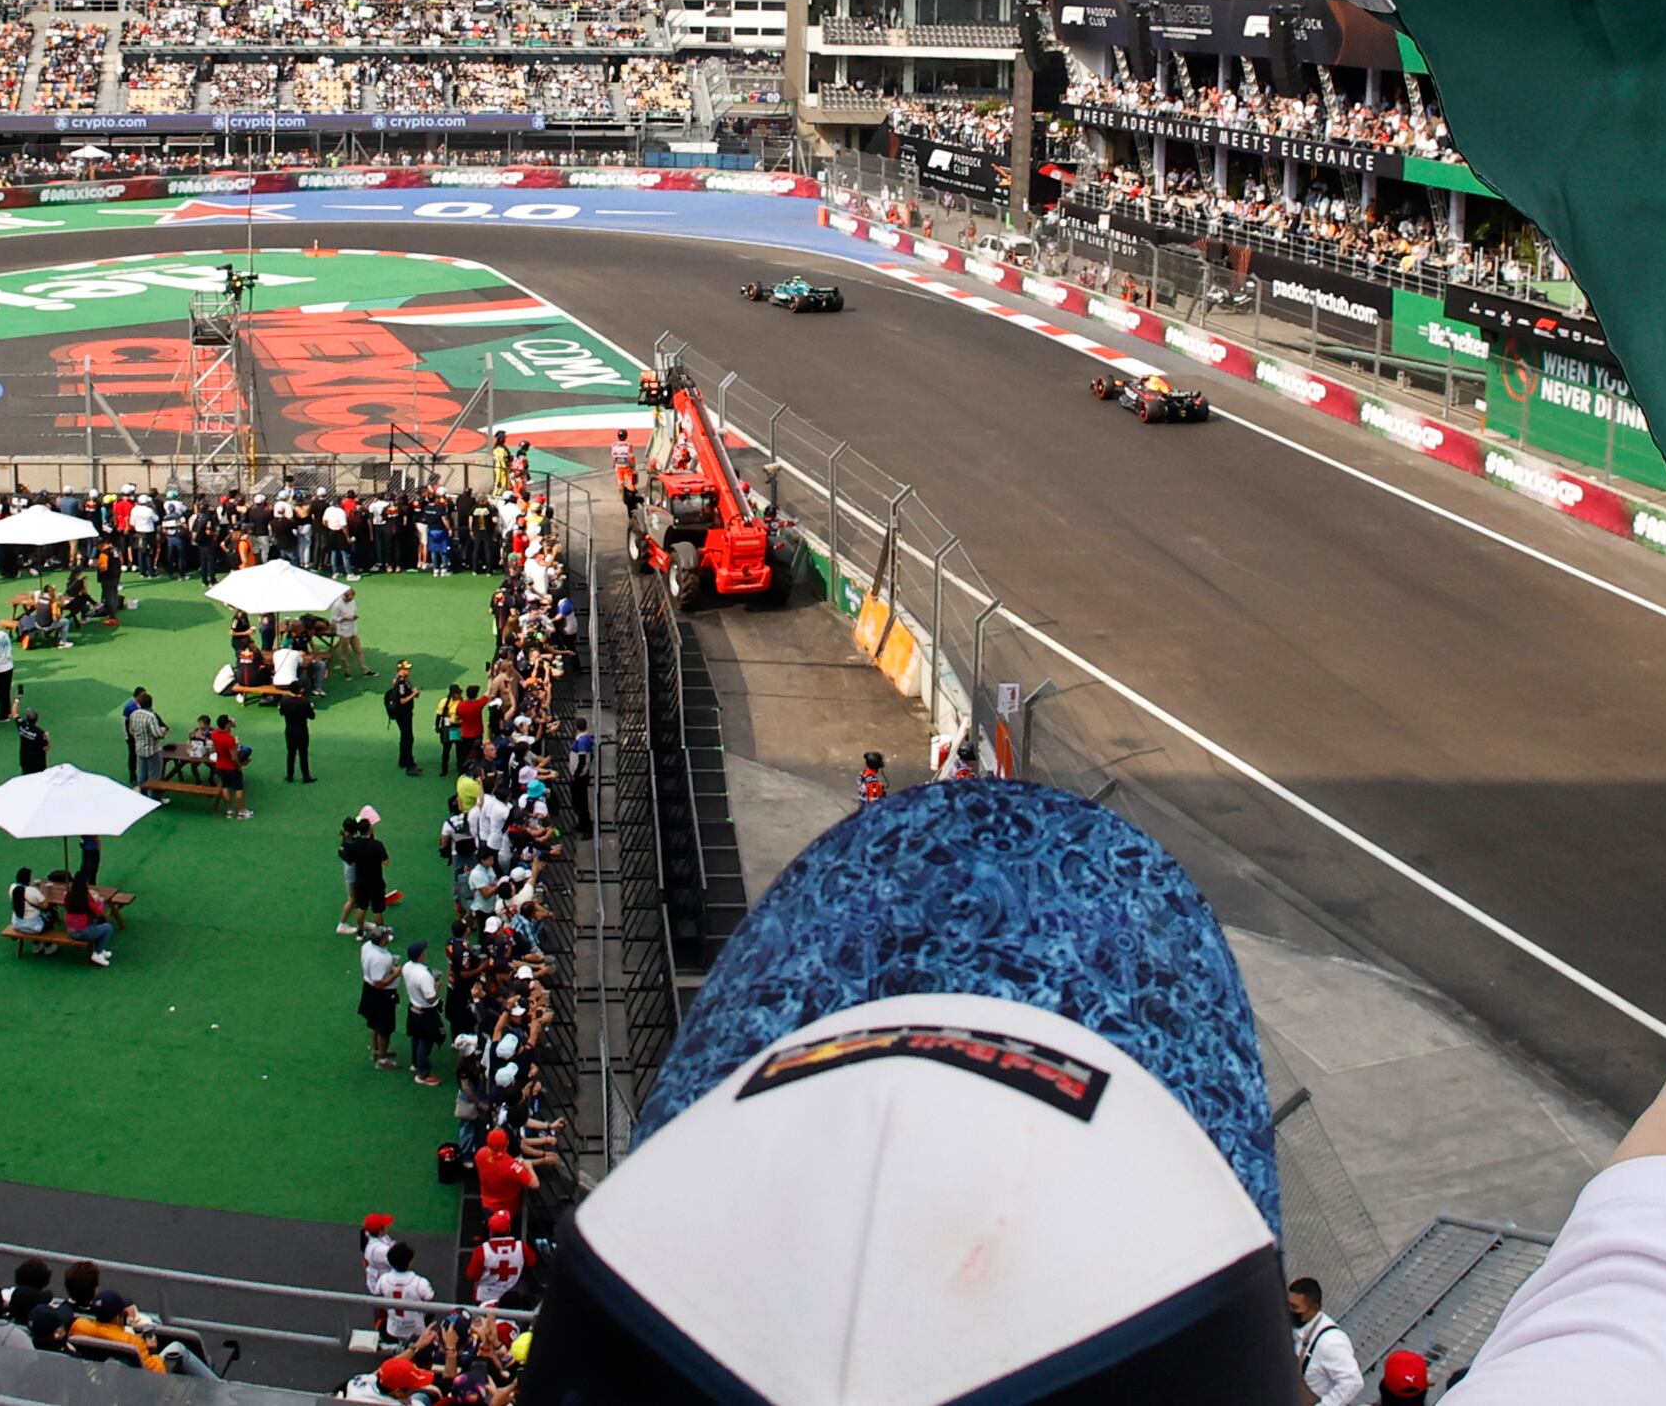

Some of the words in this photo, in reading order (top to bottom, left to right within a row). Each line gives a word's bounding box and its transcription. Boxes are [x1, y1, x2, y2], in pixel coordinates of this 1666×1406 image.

[1089, 16, 1108, 27] CLUB
[71, 116, 147, 130] crypto.com
[230, 115, 306, 129] crypto.com
[389, 114, 466, 129] crypto.com
[1074, 108, 1115, 127] WHERE
[1121, 115, 1210, 142] ADRENALINE
[1219, 129, 1271, 153] MEETS
[1281, 141, 1376, 174] ELEGANCE
[954, 163, 970, 176] CLUB
[413, 201, 581, 220] 0.0
[1256, 360, 1326, 402] #MexicoGP
[1543, 350, 1586, 385] WHEN
[1541, 378, 1592, 415] NEVER
[1361, 402, 1444, 449] #MexicoGP
[1486, 452, 1583, 506] #MexicoGP
